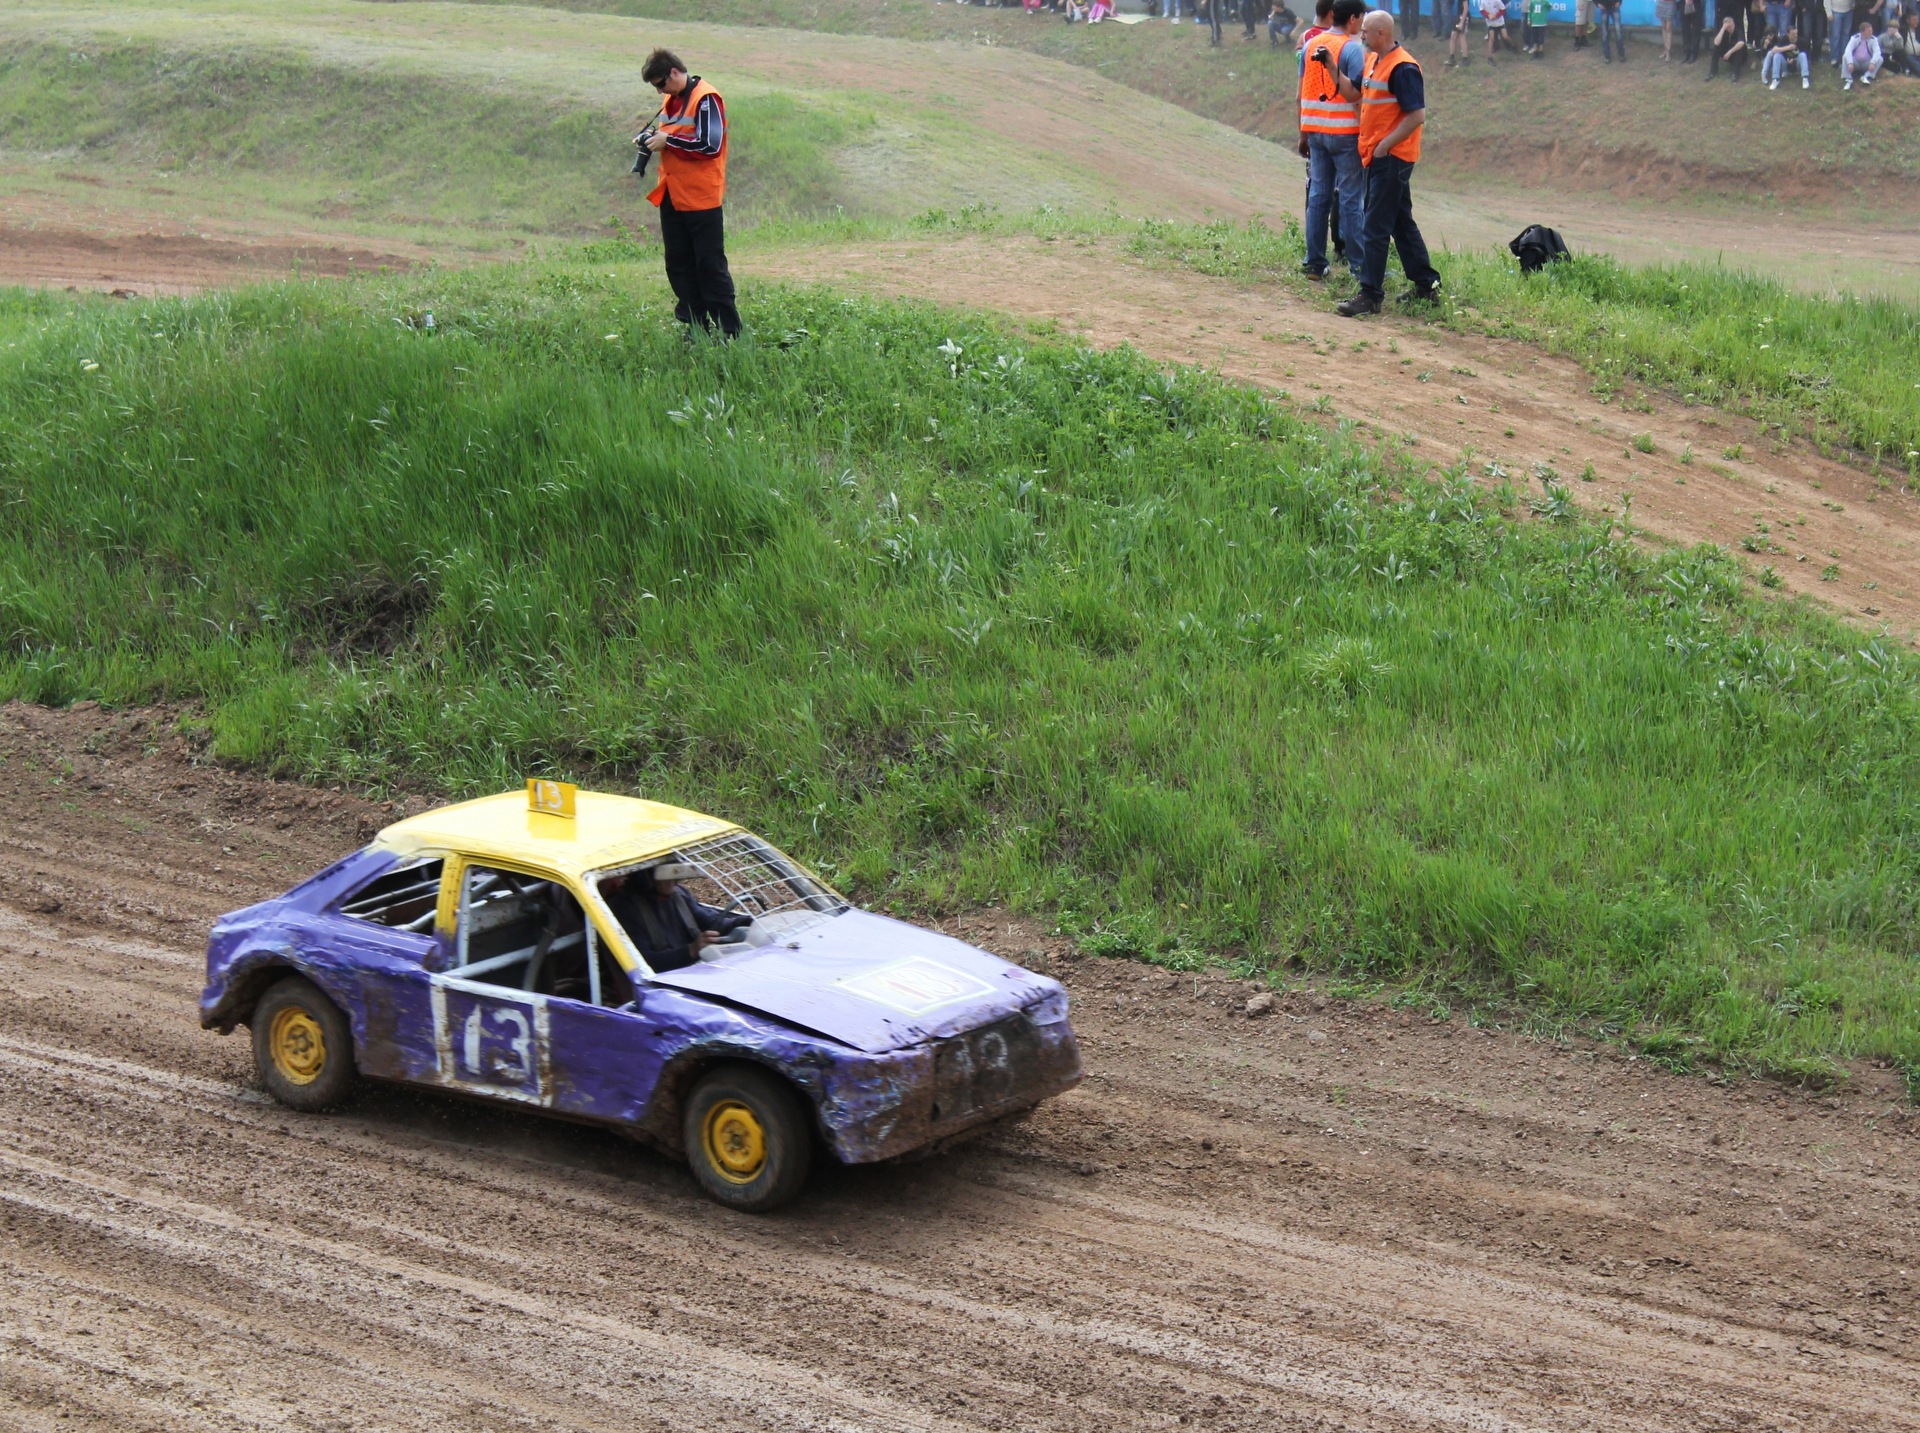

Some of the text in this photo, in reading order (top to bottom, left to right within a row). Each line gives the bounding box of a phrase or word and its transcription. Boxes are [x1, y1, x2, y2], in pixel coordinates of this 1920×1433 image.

[535, 781, 563, 809] 13
[876, 968, 964, 1003] 13
[463, 1003, 531, 1083] 13
